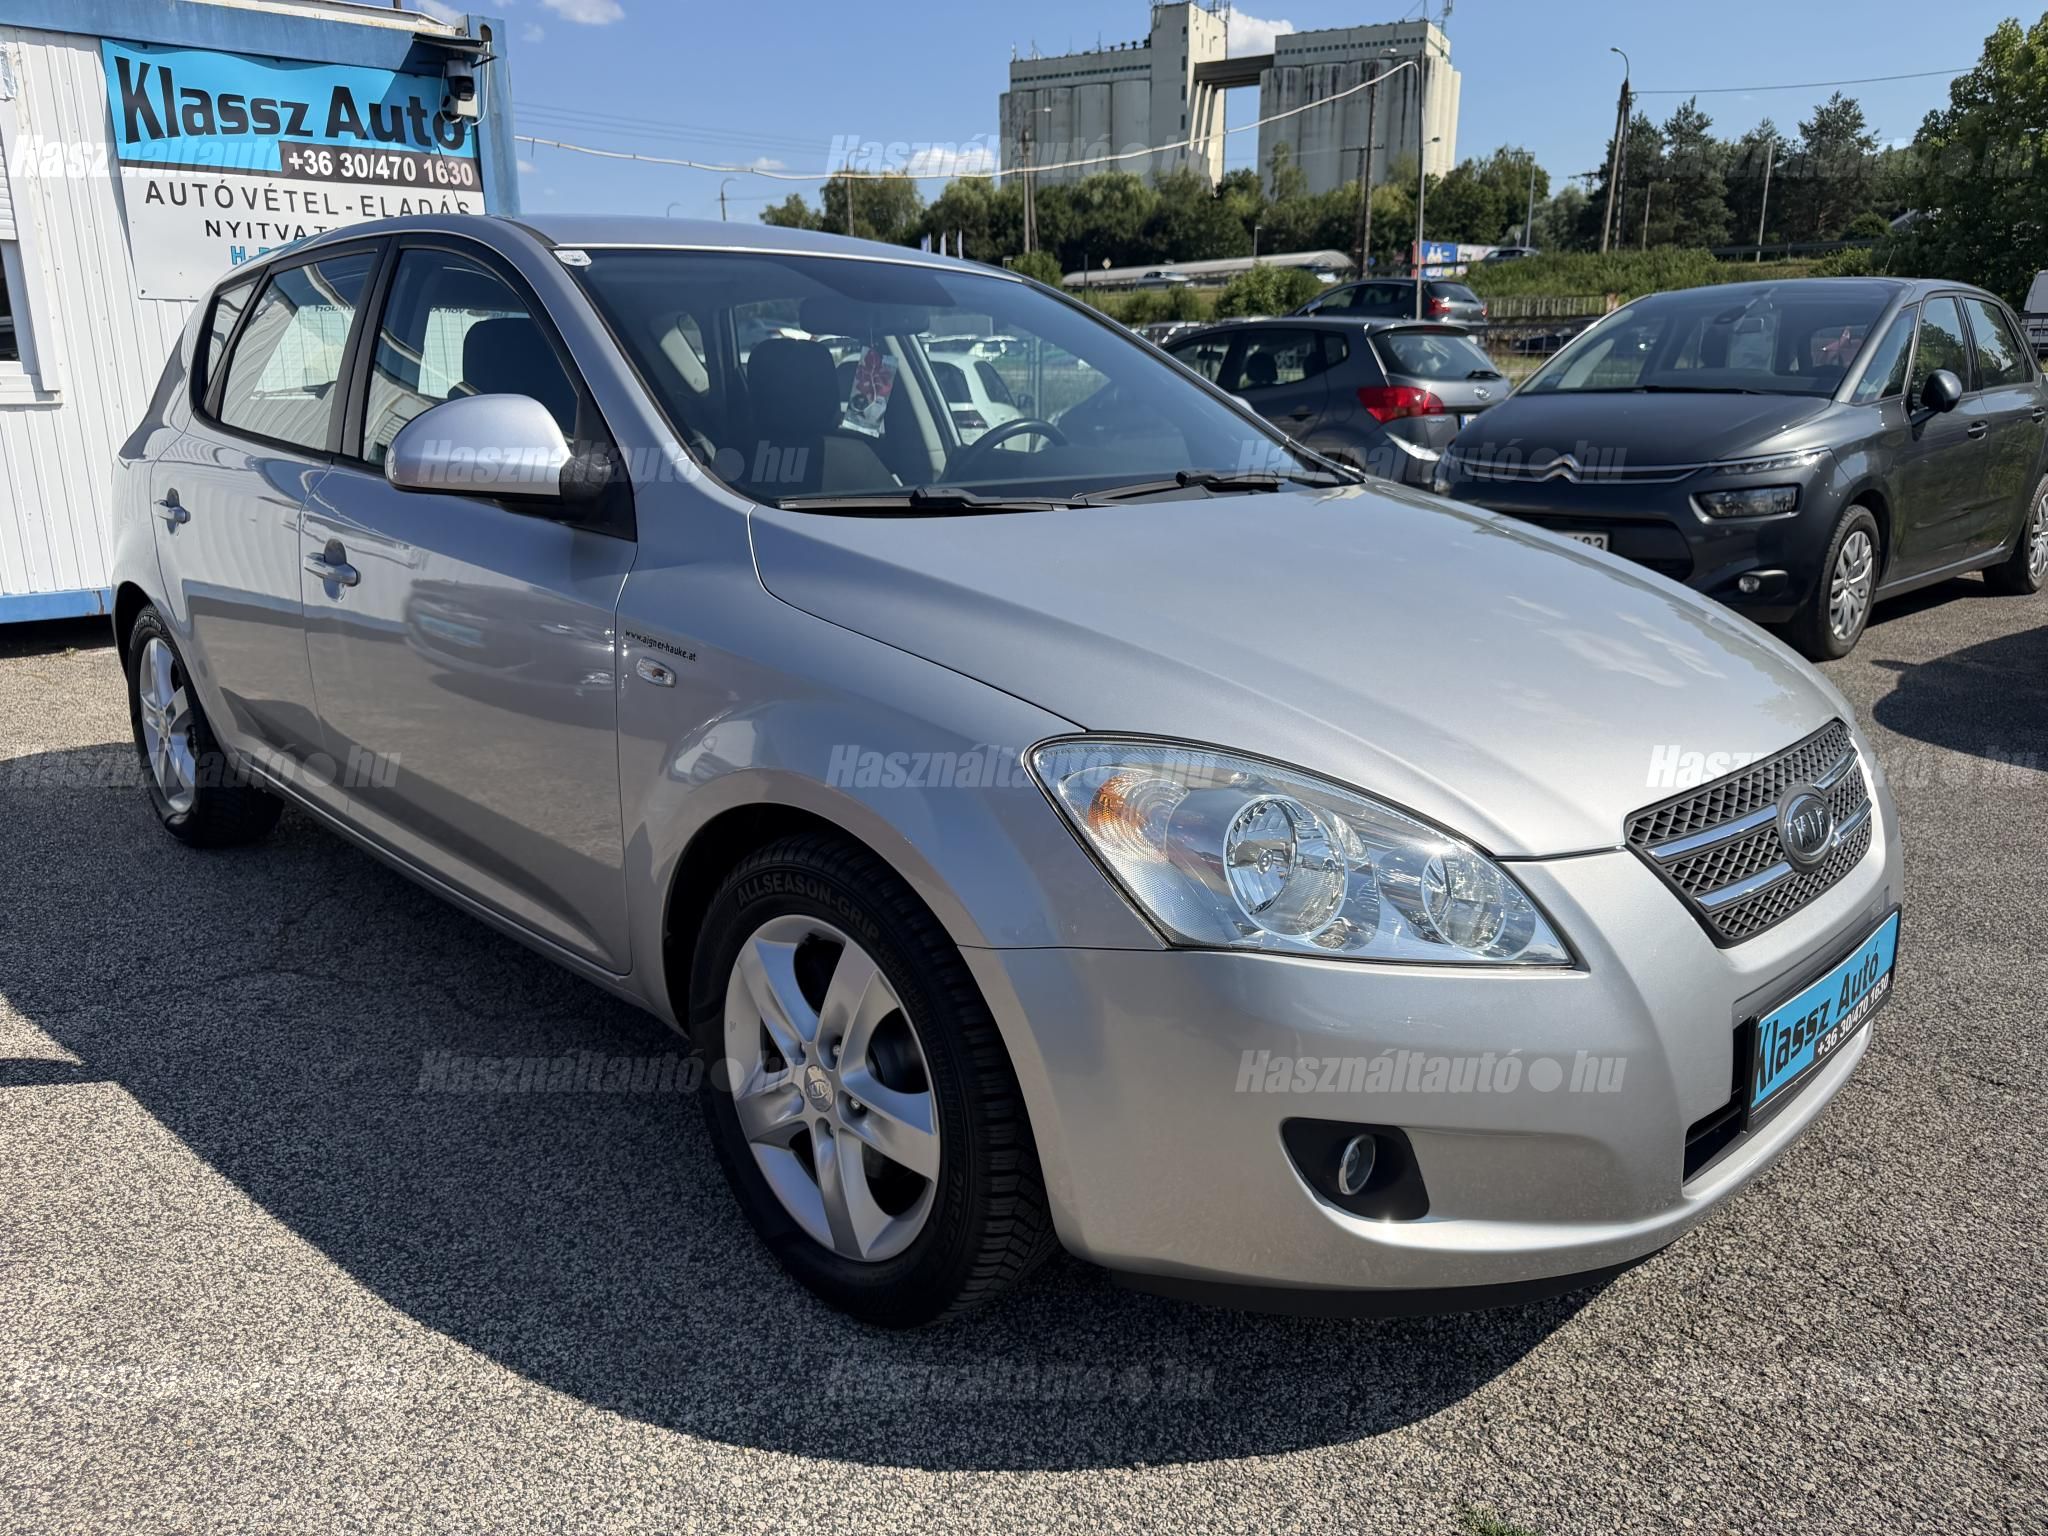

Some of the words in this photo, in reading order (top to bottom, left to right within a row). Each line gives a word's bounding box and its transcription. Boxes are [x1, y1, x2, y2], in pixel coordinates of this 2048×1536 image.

[115, 55, 314, 145] Klassz
[325, 85, 466, 151] Autó
[288, 149, 334, 175] +36
[340, 151, 417, 182] 30/470
[423, 162, 474, 187] 1630
[625, 629, 697, 662] www.aigner-hauke.at
[1753, 998, 1832, 1094] Klassz
[1837, 940, 1880, 1018] Autó
[1817, 1026, 1838, 1056] +36
[1840, 995, 1869, 1038] 30/470
[1870, 972, 1890, 1005] 1630
